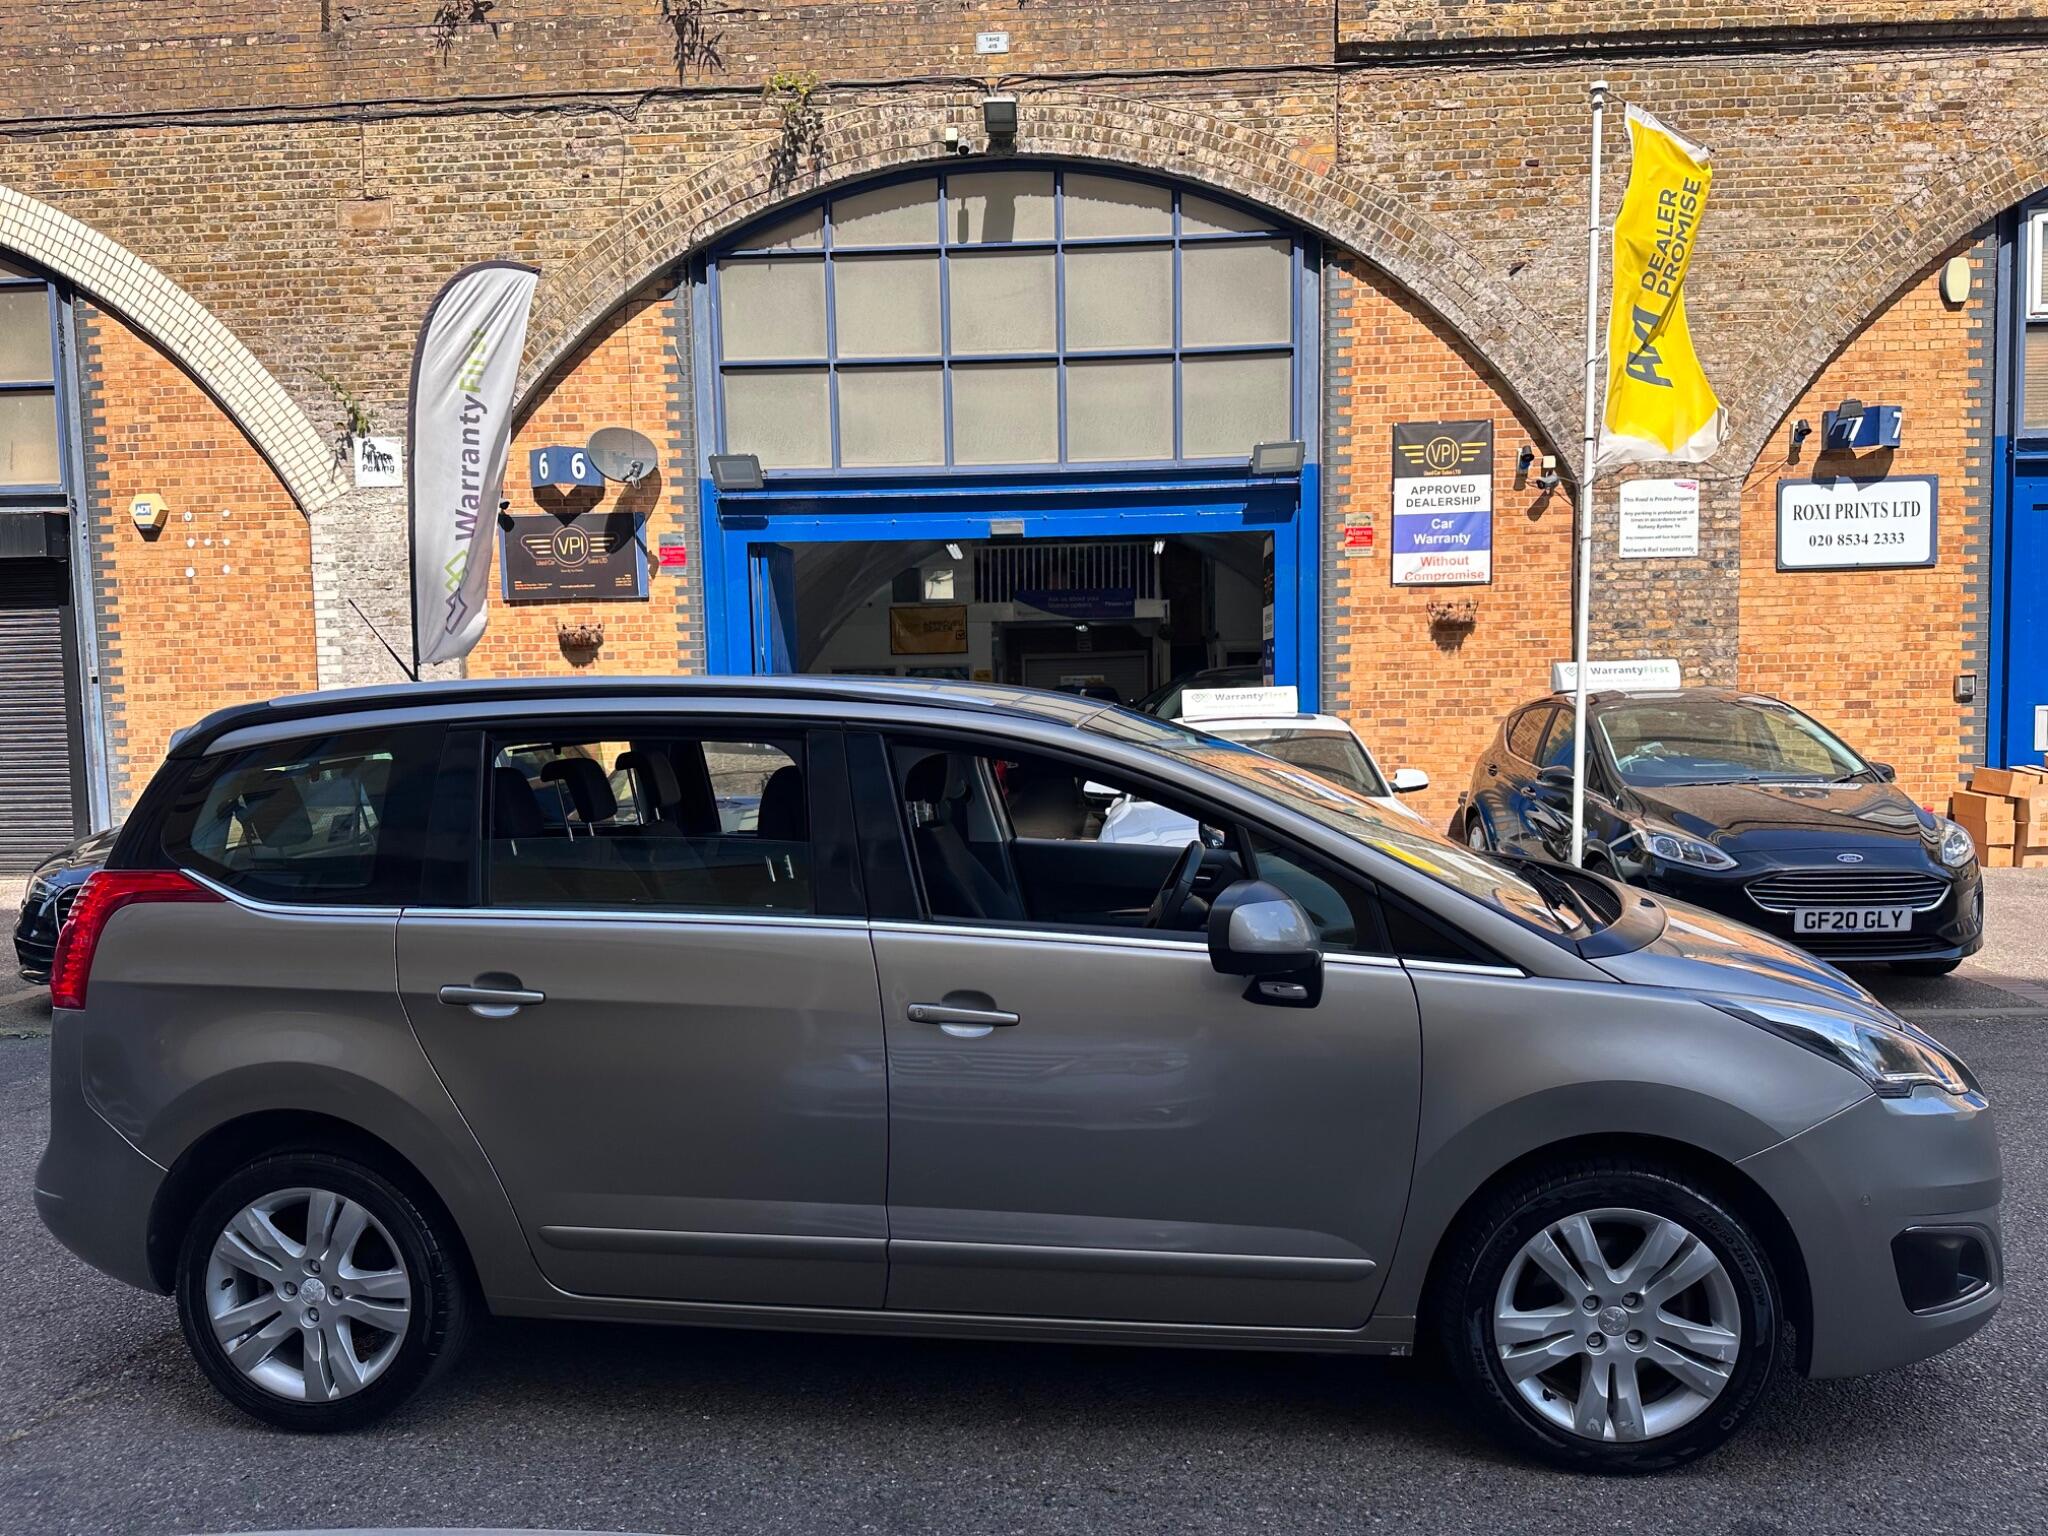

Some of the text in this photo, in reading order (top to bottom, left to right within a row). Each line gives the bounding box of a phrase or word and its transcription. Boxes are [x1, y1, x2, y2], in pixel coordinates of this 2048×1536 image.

[1641, 188, 1678, 292] DEALER
[1656, 176, 1702, 298] PROMISE
[1892, 411, 1902, 438] 7
[1431, 444, 1455, 463] VPI
[362, 464, 394, 474] Paring
[539, 452, 549, 480] 6
[571, 452, 586, 480] 6
[1410, 483, 1476, 495] APPROVED
[1406, 496, 1481, 508] DEALERSHIP
[1793, 501, 1921, 521] ROXI PRINTS LTD
[1431, 518, 1454, 529] Car
[557, 536, 584, 555] VPI
[1414, 532, 1470, 546] Warranty
[1809, 532, 1905, 547] 020 8534 2333
[1420, 554, 1469, 567] Without
[1404, 570, 1485, 582] Compromise
[1590, 666, 1670, 676] WarrantyFirst
[1804, 910, 1903, 930] GF20 GLY
